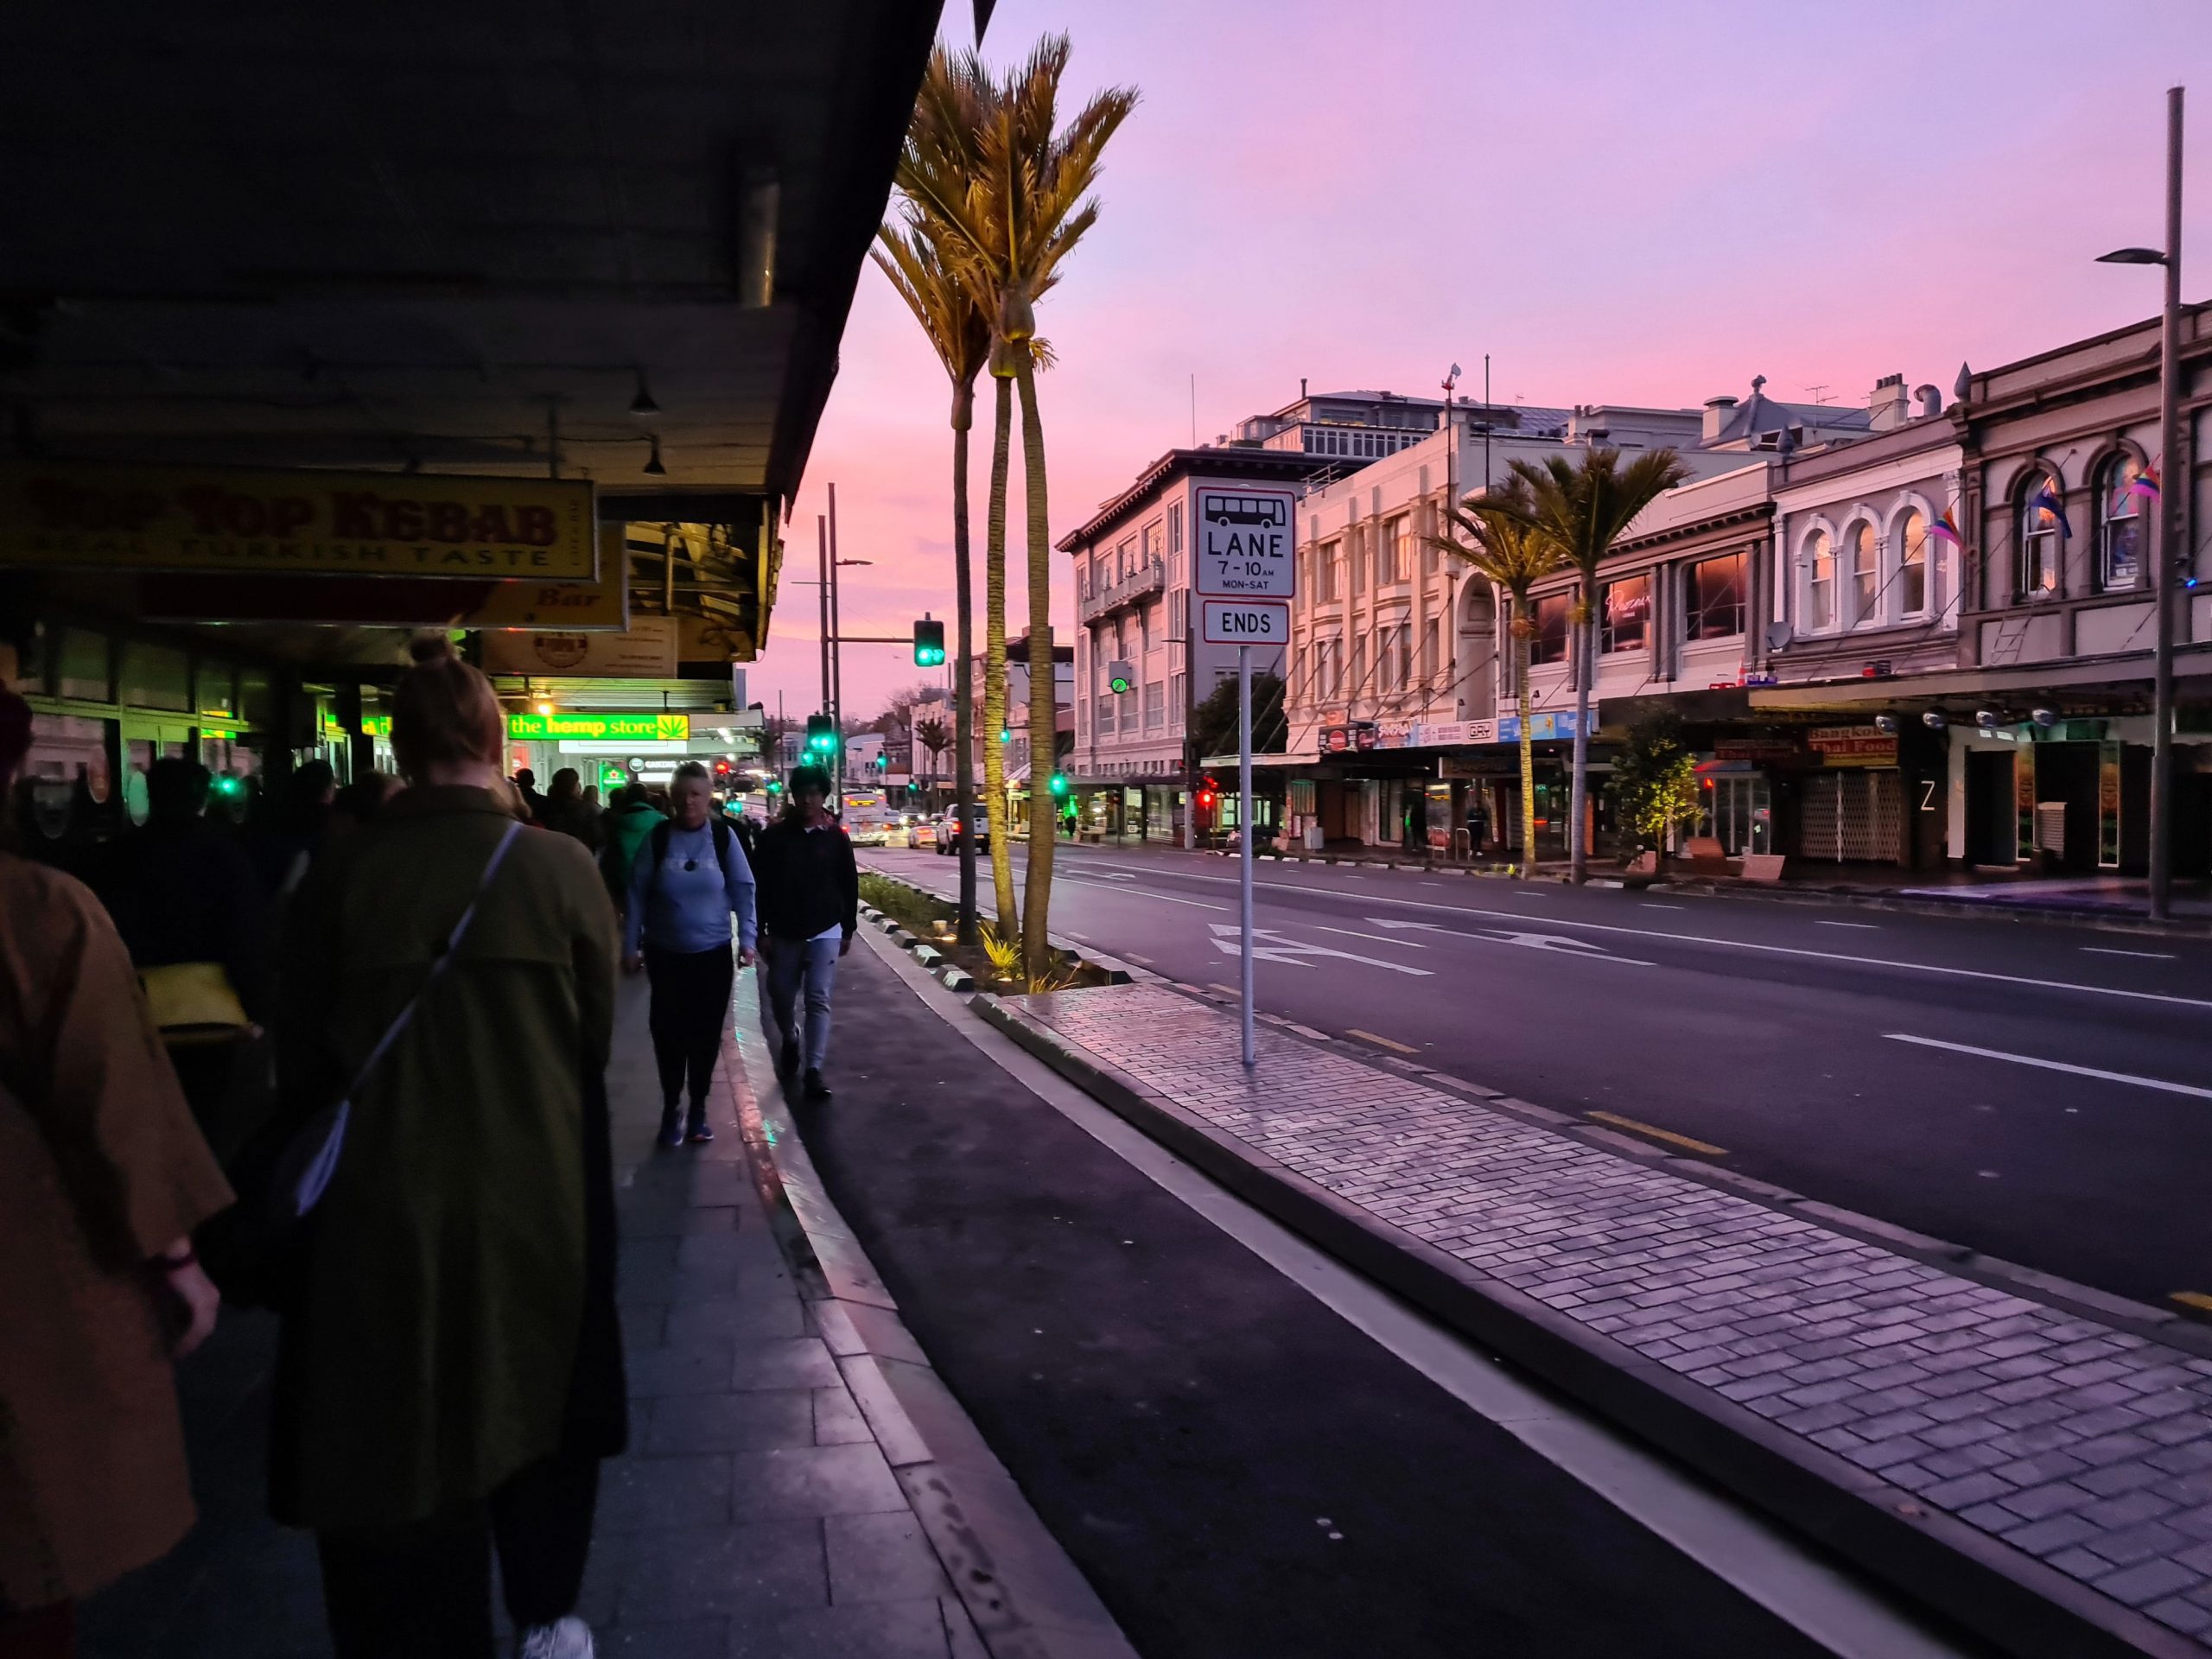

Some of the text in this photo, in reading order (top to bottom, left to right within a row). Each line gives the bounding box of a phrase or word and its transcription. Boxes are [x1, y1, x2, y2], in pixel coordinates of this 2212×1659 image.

[333, 490, 556, 546] KEBAB
[179, 537, 385, 563] TURKISH
[411, 546, 549, 568] TASTE
[1207, 531, 1284, 558] LANE
[1223, 580, 1269, 590] MON-SAT
[536, 588, 601, 607] Bar
[1222, 612, 1271, 633] ENDS
[512, 717, 657, 738] the hemp store
[1810, 740, 1897, 753] Thai Food
[1921, 780, 1936, 810] Z
